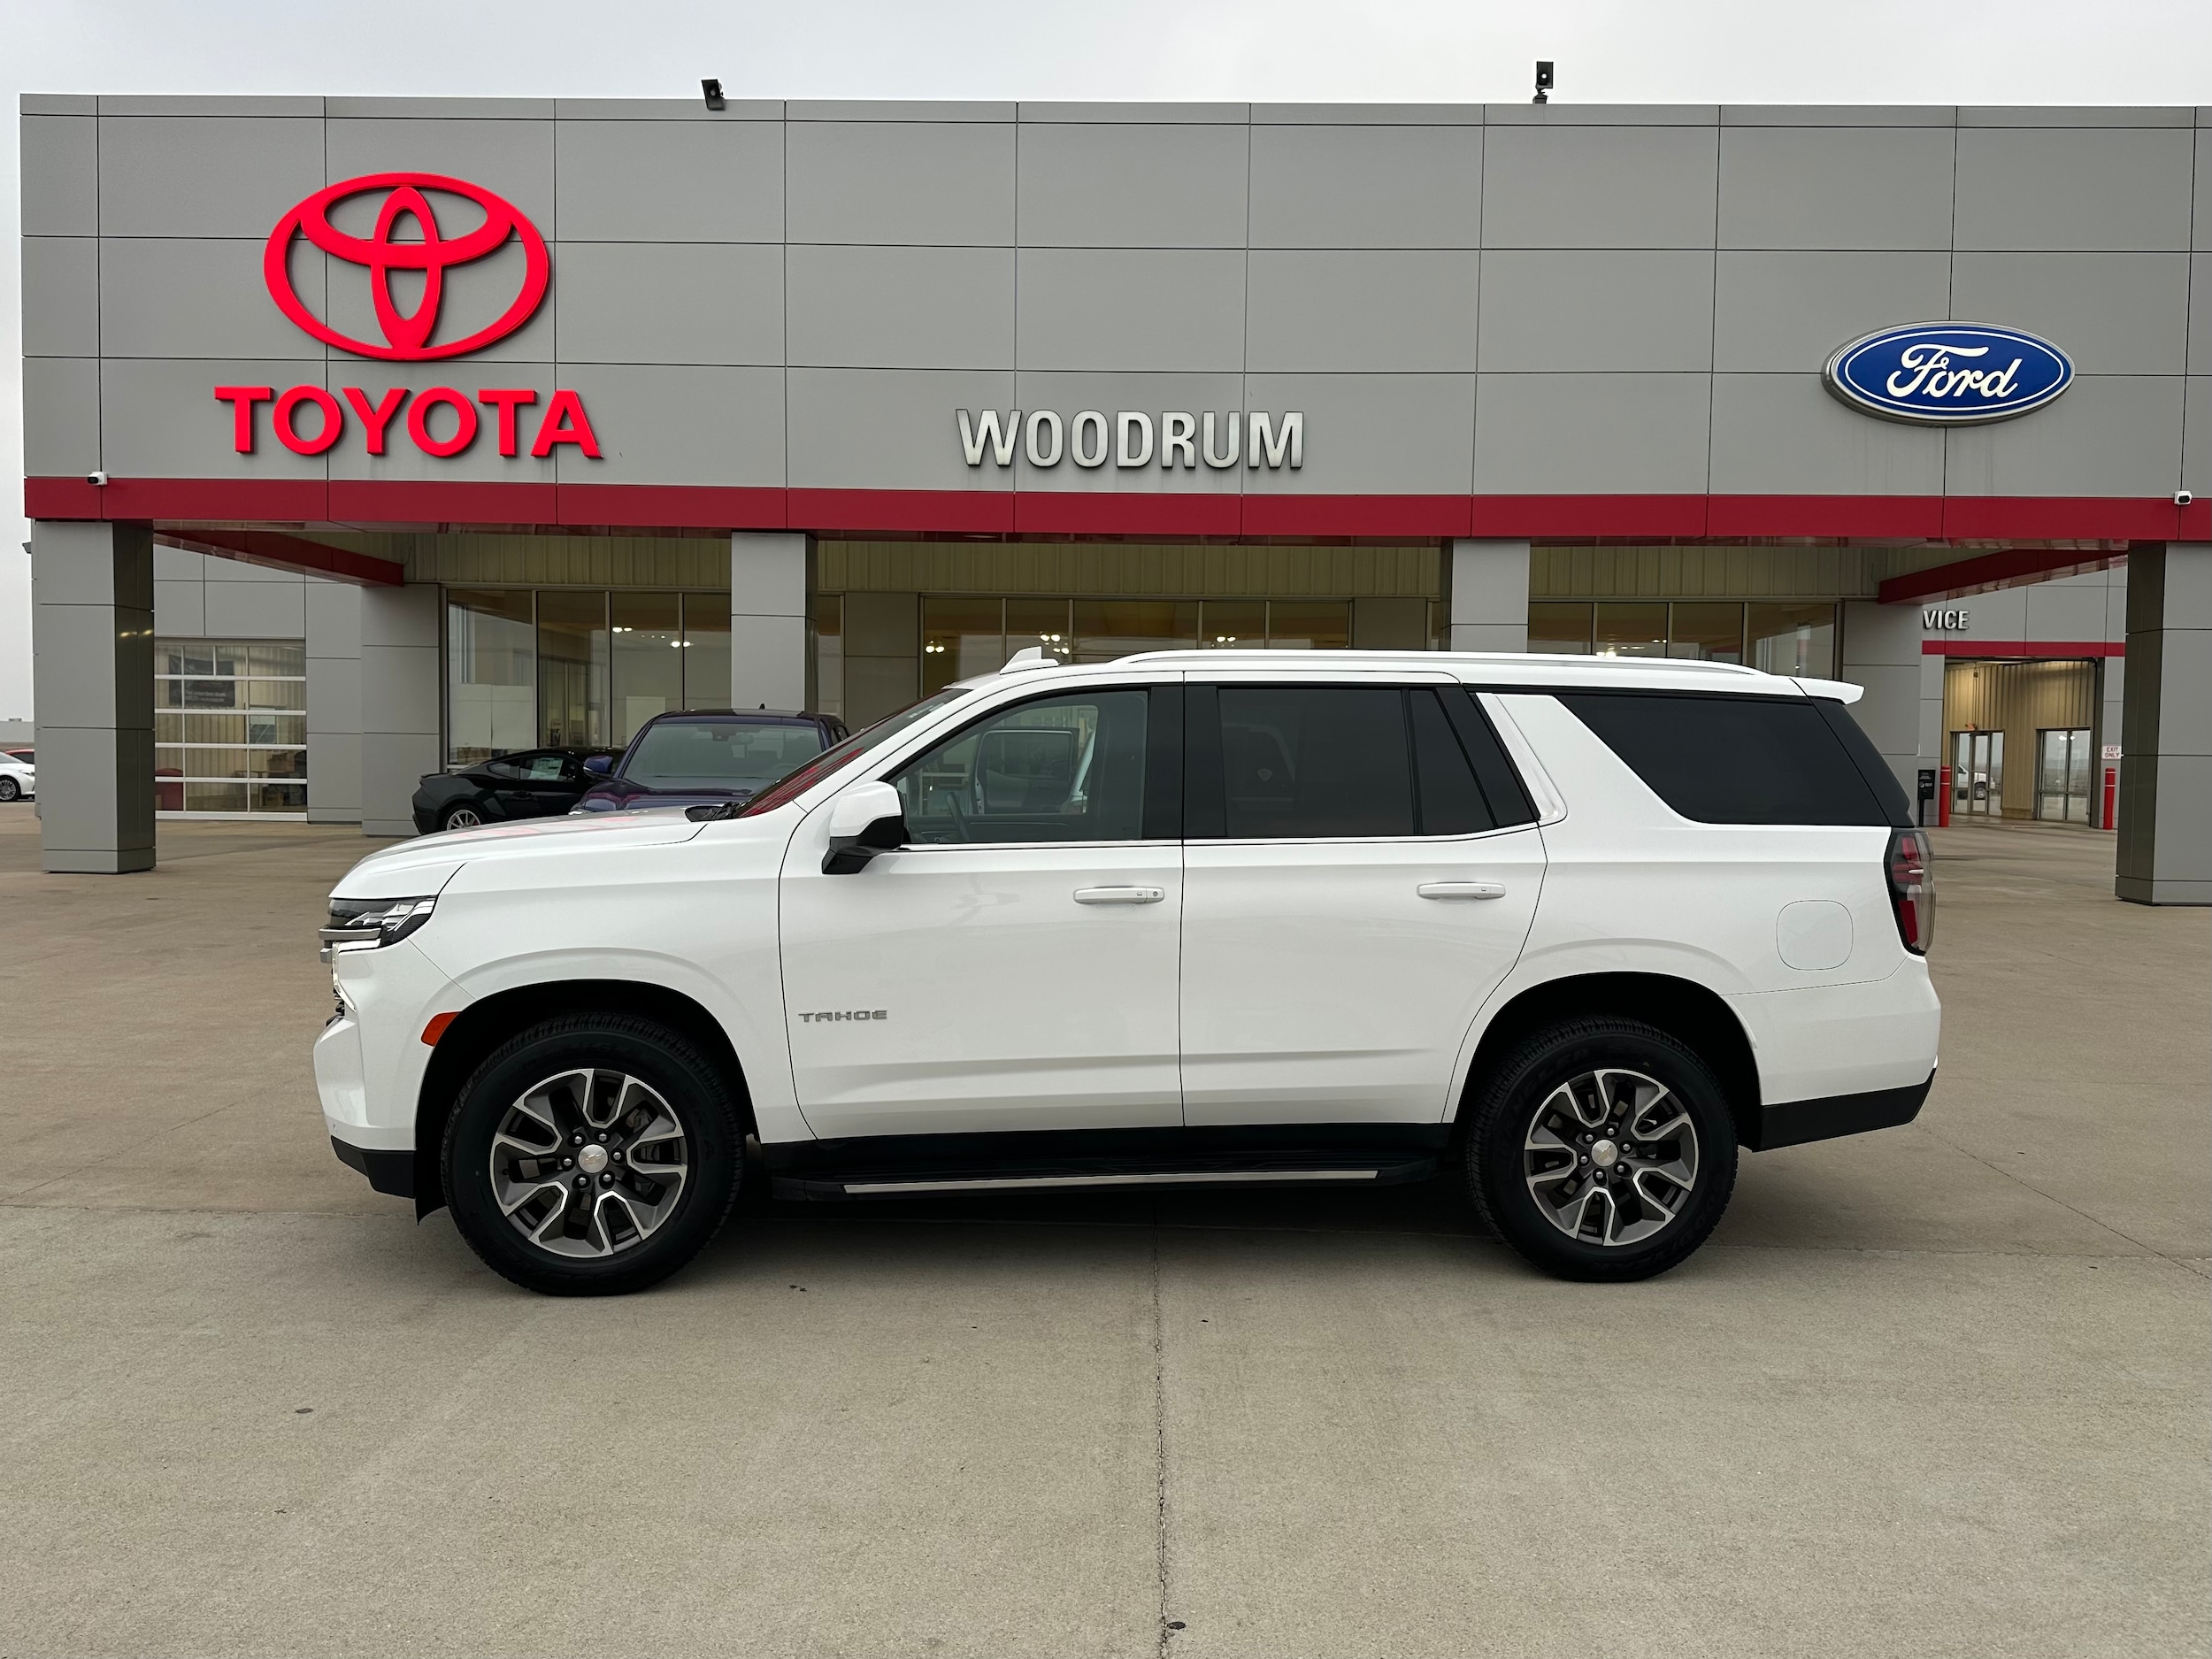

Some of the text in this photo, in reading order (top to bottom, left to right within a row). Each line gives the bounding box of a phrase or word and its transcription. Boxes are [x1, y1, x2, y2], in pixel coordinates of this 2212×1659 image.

[1886, 343, 2023, 398] Ford
[214, 385, 604, 459] TOYOTA
[955, 409, 1304, 469] WOODRUM
[798, 1010, 887, 1023] TAHOE
